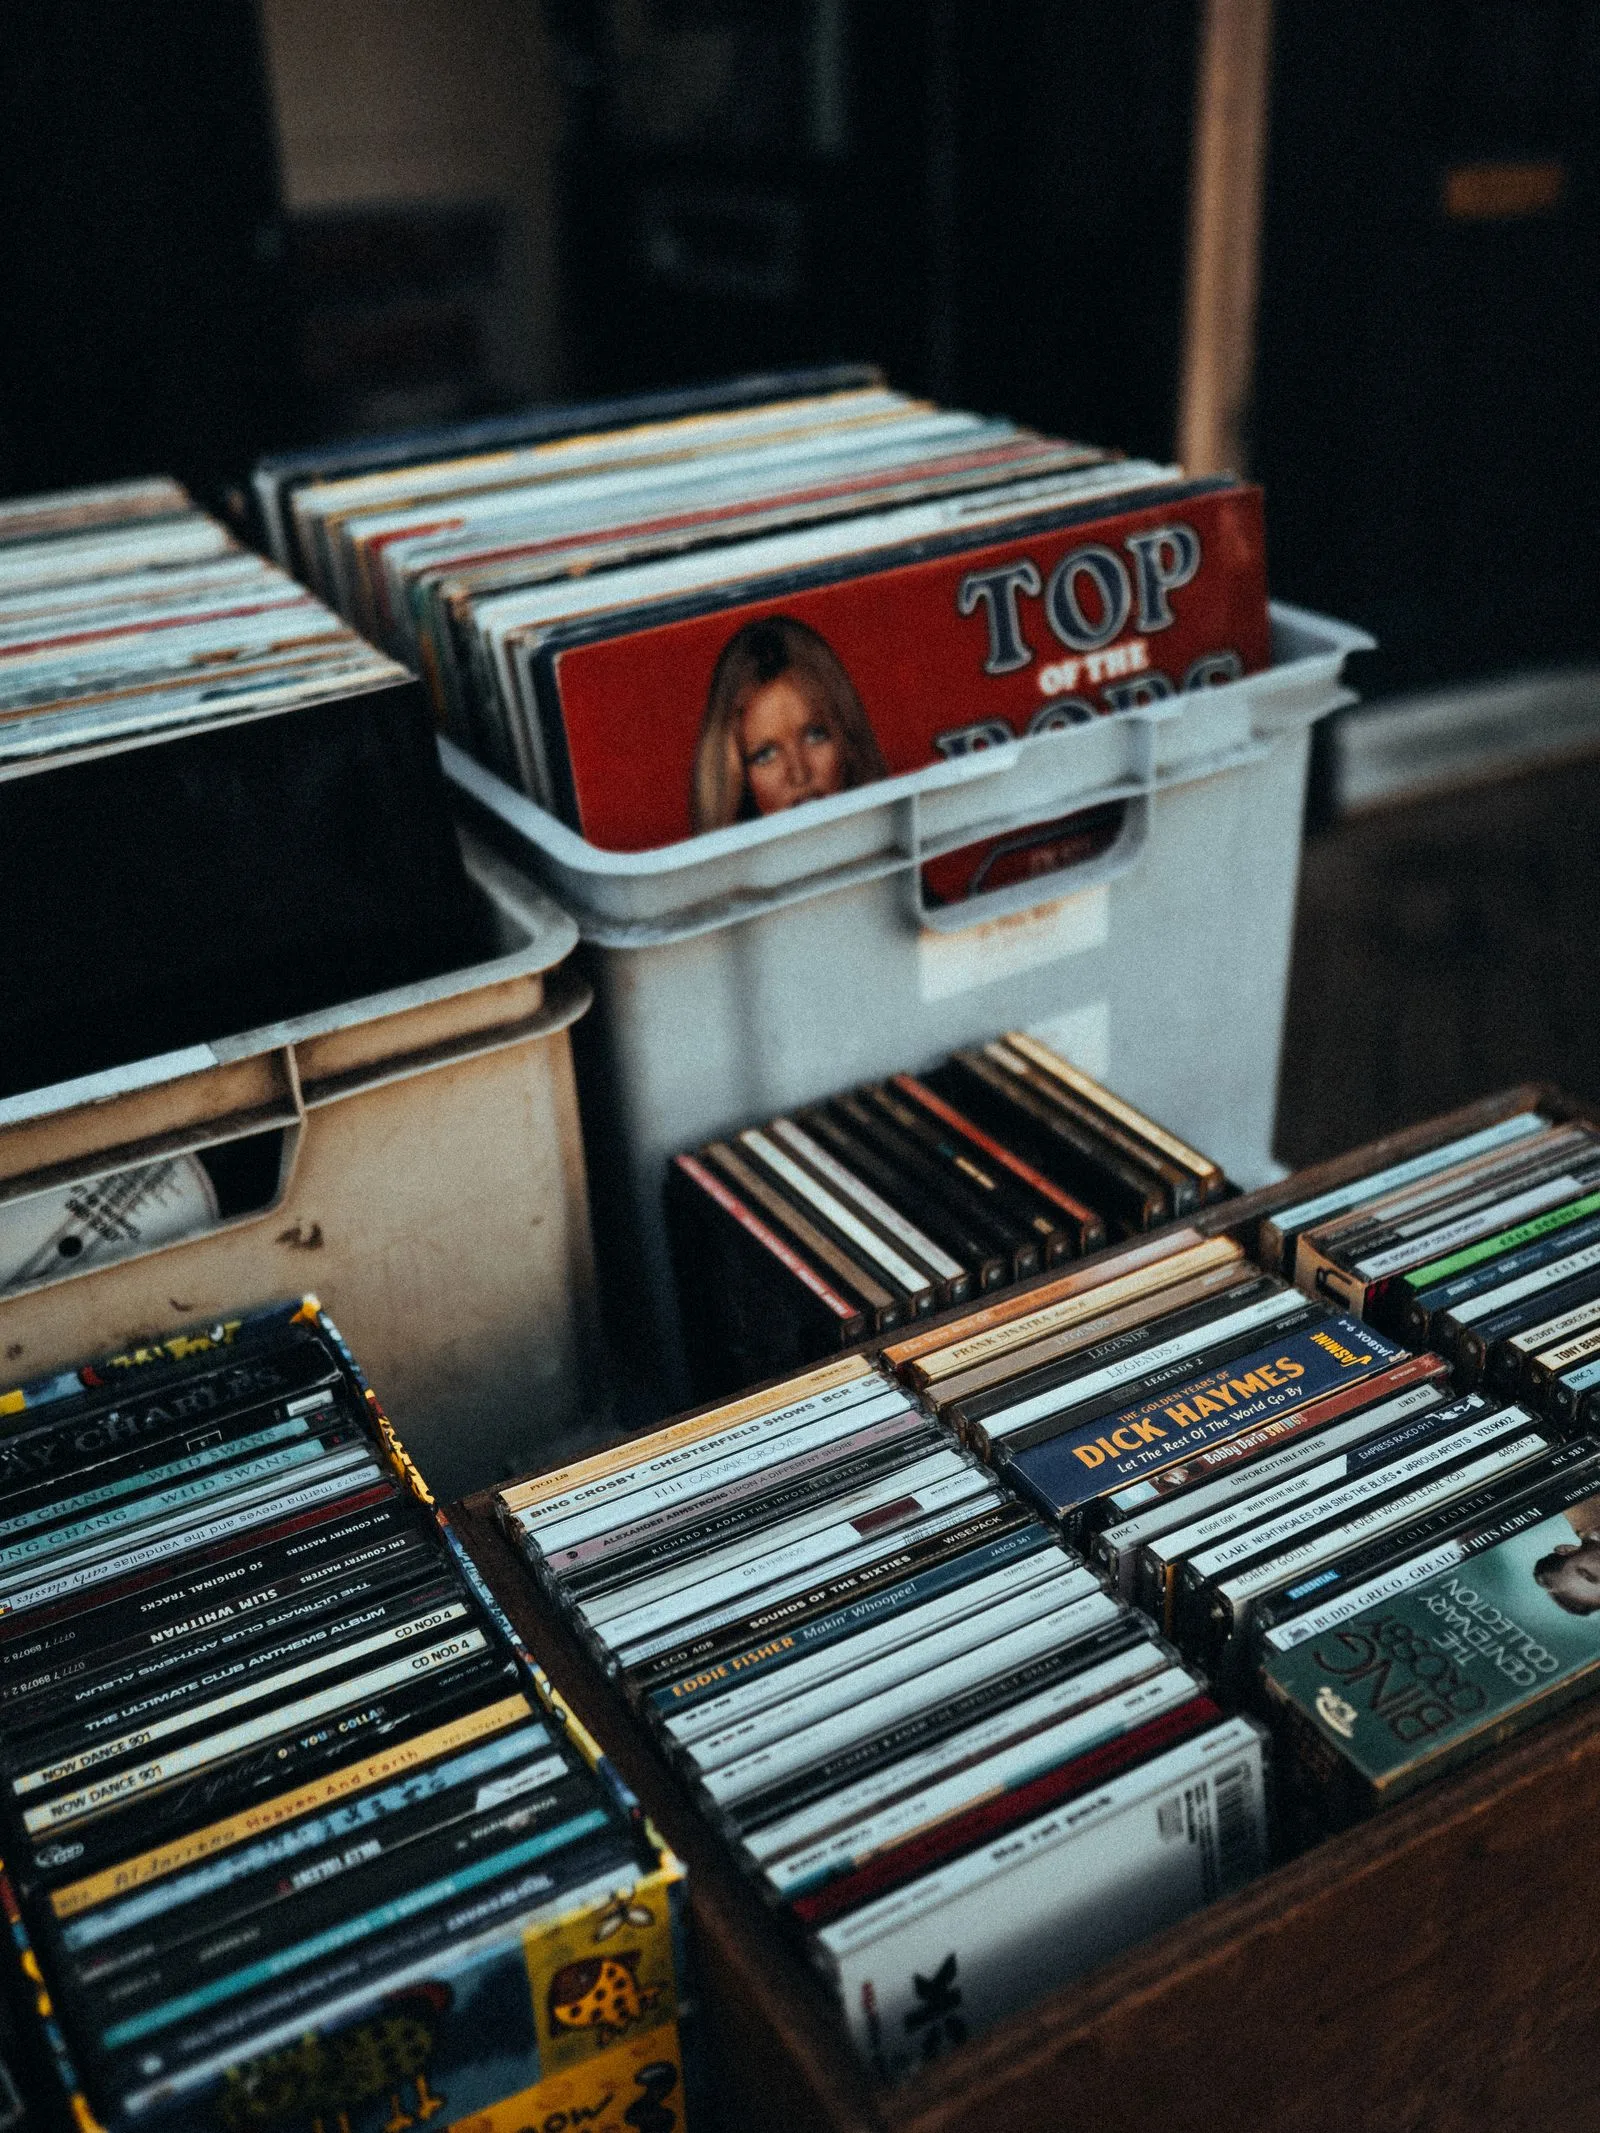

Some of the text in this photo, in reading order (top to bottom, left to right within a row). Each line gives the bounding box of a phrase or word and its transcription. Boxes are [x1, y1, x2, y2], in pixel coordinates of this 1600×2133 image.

[957, 520, 1203, 675] TOP
[952, 1315, 1052, 1359] FRANK SINATRA
[1089, 1329, 1150, 1360] LEGENDS
[1107, 1347, 1173, 1379] LEGENDS
[1144, 1358, 1204, 1387] LEGENDS 2
[1310, 1332, 1373, 1367] JASMINE
[1356, 1330, 1394, 1360] JASBOX
[1553, 1345, 1581, 1361] TONY
[1569, 1372, 1587, 1383] DISC
[1071, 1356, 1306, 1469] DICK HAYMES
[1117, 1385, 1303, 1473] Let The Rest Of The World Go By
[1118, 1411, 1140, 1423] THE
[1140, 1392, 1183, 1414] GOLDEN
[1181, 1376, 1216, 1399] YEARS
[1216, 1370, 1231, 1381] OF
[1202, 1413, 1308, 1465] Bobby Darin SWINGS
[1357, 1420, 1434, 1460] EMPRESS RAJCD 911
[36, 1430, 276, 1520] CHANG WILD SWANS
[47, 1453, 292, 1545] CHANG WILD SWANS
[529, 1478, 553, 1491] PYCD
[530, 1499, 571, 1519] BING
[574, 1472, 636, 1501] CROSBY
[650, 1424, 760, 1473] CHESTERFIELD
[763, 1403, 816, 1427] SHOWS
[822, 1389, 853, 1403] BCR
[603, 1441, 854, 1547] ALEXANDER ARMSTRONG UPON DIFFERENT SHORE
[1111, 1526, 1133, 1540] DISC
[1230, 1449, 1300, 1486] UNFORGETTABLE
[1299, 1440, 1326, 1455] FIFTIES
[1398, 1397, 1416, 1408] UKD
[1416, 1389, 1431, 1400] 103
[1214, 1416, 1515, 1562] FLARE NIGHTINGALES CAN SING THE BLUES VARIOUS ARTISTS VIX9002
[1382, 1496, 1417, 1516] WOULD
[1416, 1482, 1444, 1499] LEAVE
[1444, 1471, 1466, 1485] YOU
[17, 1484, 333, 1603] martha reeves and the vandellas early classics
[651, 1462, 869, 1554] RICHARD ADAM THE IMPOSSIBLE DREAM
[1397, 1457, 1569, 1545] COLE PORTER AVC
[140, 1513, 390, 1612] EMI COUNTRY MASTERS ORIGINAL TRACKS
[750, 1600, 807, 1629] SOUNDS
[809, 1591, 827, 1603] OF
[830, 1578, 859, 1594] THE
[859, 1554, 912, 1580] SIXTIES
[943, 1515, 1003, 1545] WISEPACK
[1313, 1603, 1359, 1628] BUDDY
[1358, 1579, 1403, 1606] GRECO
[1409, 1543, 1471, 1580] GREATEST
[1470, 1531, 1501, 1554] HITS
[1499, 1508, 1543, 1537] ALBUM
[20, 1538, 406, 1693] EMI COUNTRY MASTERS SLIM WHITMAN 89078
[75, 1582, 371, 1701] THE ULTIMATE CLUB ANTHEMS ALBUM
[672, 1666, 729, 1697] EDDIE
[732, 1635, 796, 1670] FISHER
[802, 1612, 849, 1640] Makin'
[851, 1583, 917, 1619] Whoopee!
[990, 1542, 1017, 1558] JASCD
[1017, 1535, 1031, 1546] 361
[1419, 1594, 1537, 1687] CENTENARY
[1432, 1630, 1478, 1667] THE
[1441, 1578, 1559, 1673] COLLECTION
[42, 1610, 452, 1782] NOW DANCE 901 CD NOD 4
[84, 1607, 386, 1731] THE ULTIMATE CLUB ANTHEMS ALBUM
[1313, 1632, 1454, 1742] BING
[51, 1639, 470, 1817] NOW DANCE 901 CD NOD 4
[367, 1749, 419, 1777] Earth
